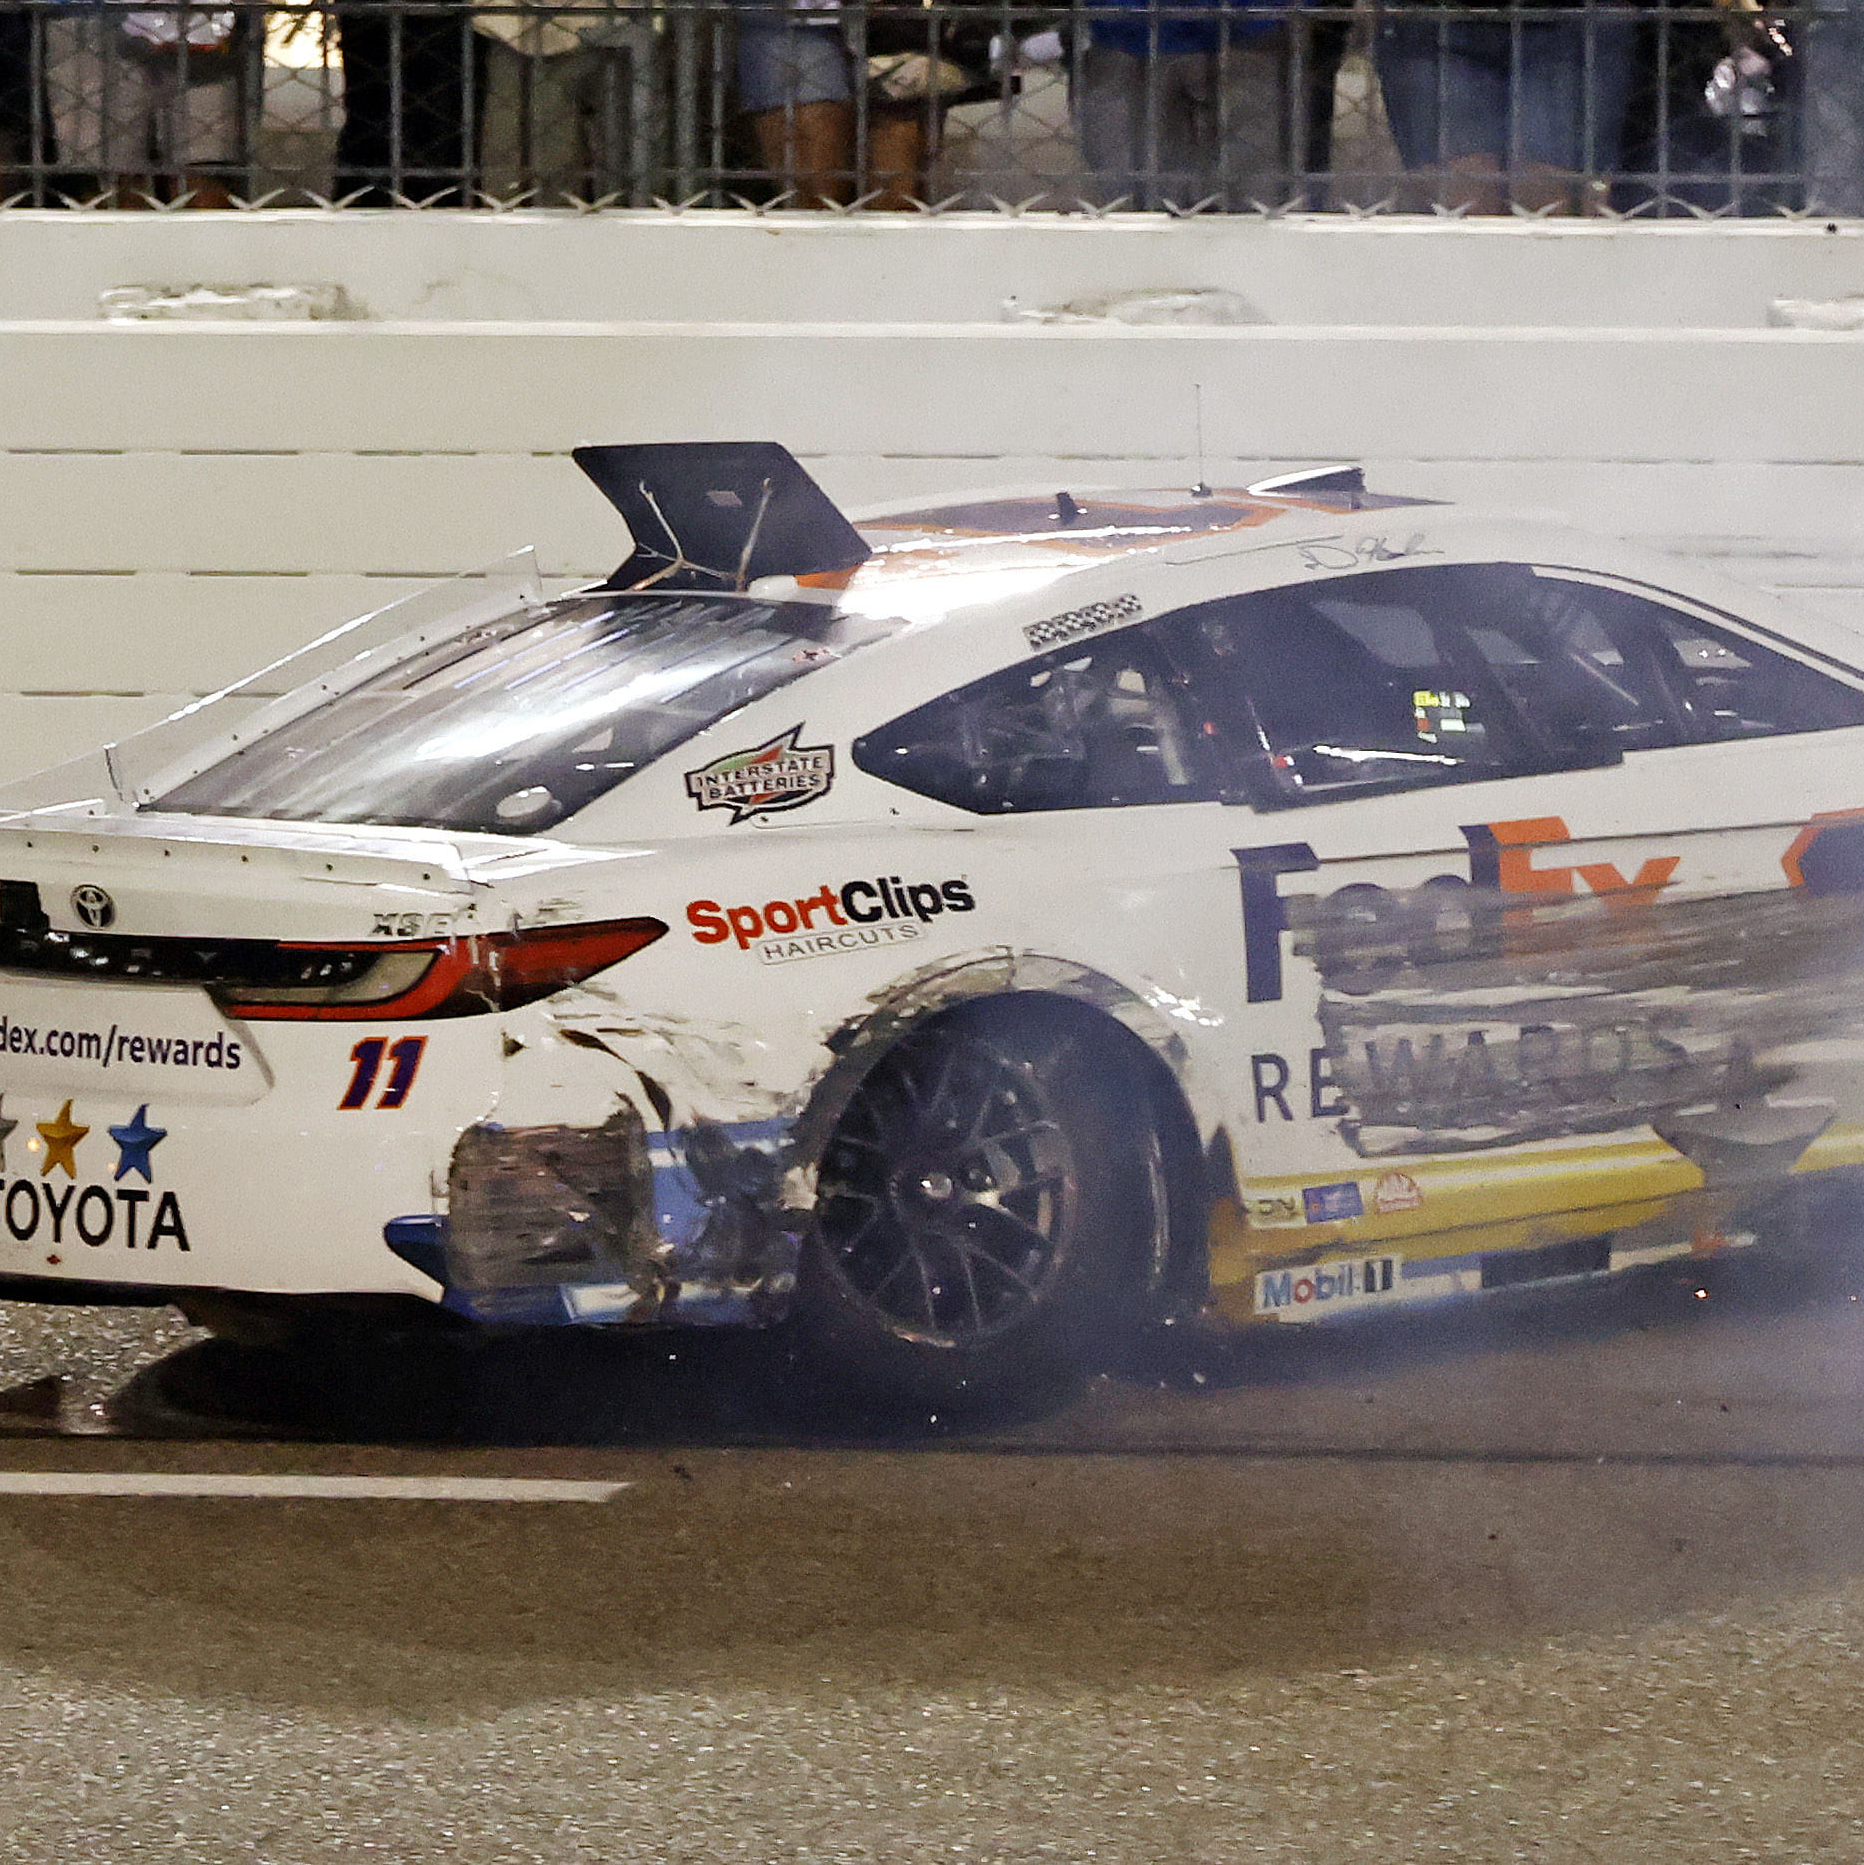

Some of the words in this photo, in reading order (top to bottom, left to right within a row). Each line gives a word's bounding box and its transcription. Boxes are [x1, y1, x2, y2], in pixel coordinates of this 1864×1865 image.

[696, 755, 825, 787] INTERSTATE
[708, 772, 822, 800] BATTERIES
[685, 876, 976, 950] SportClips
[763, 924, 920, 960] HAIRCUTS
[335, 1034, 429, 1111] 11
[1262, 1262, 1354, 1309] Mobil
[1364, 1259, 1394, 1294] 1
